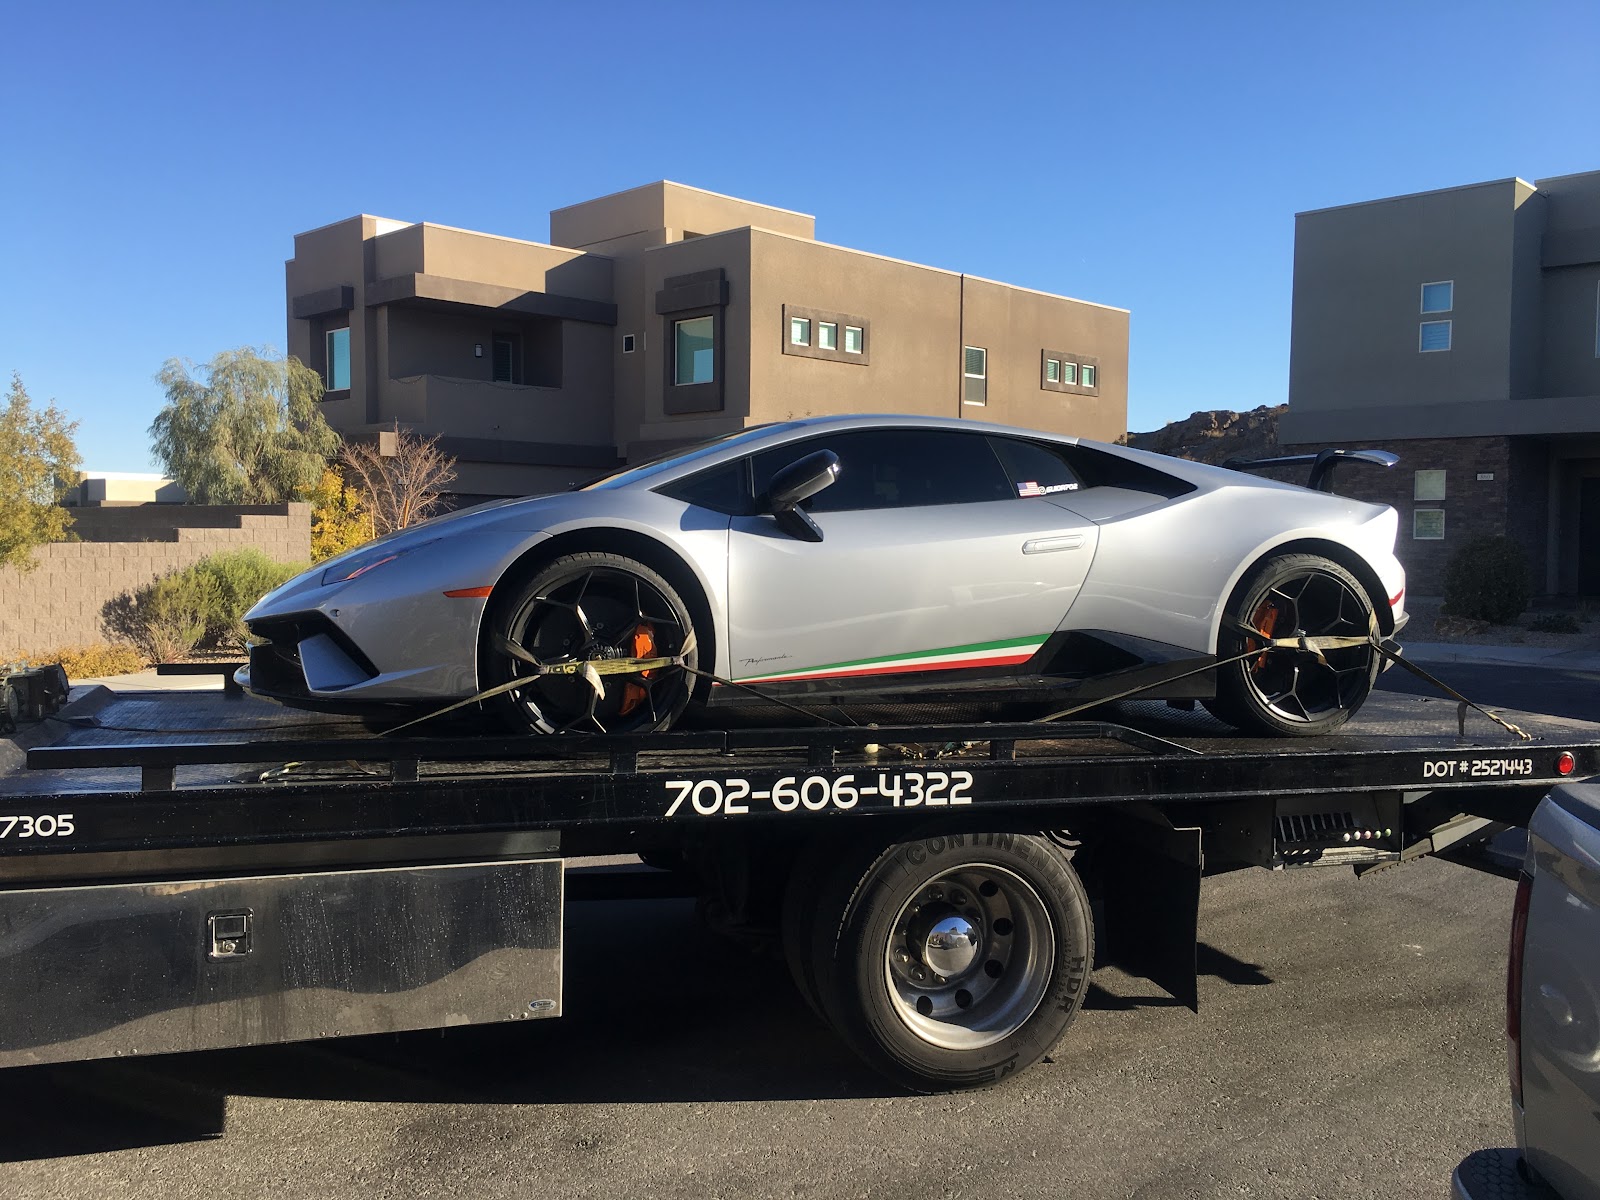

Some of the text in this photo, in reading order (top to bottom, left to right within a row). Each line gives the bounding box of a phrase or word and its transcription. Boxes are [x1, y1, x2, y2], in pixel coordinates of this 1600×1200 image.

[1423, 758, 1533, 778] DOT # 2521443
[664, 770, 974, 817] 702-606-4322
[0, 813, 75, 839] 7305
[1057, 956, 1085, 1014] HDR
